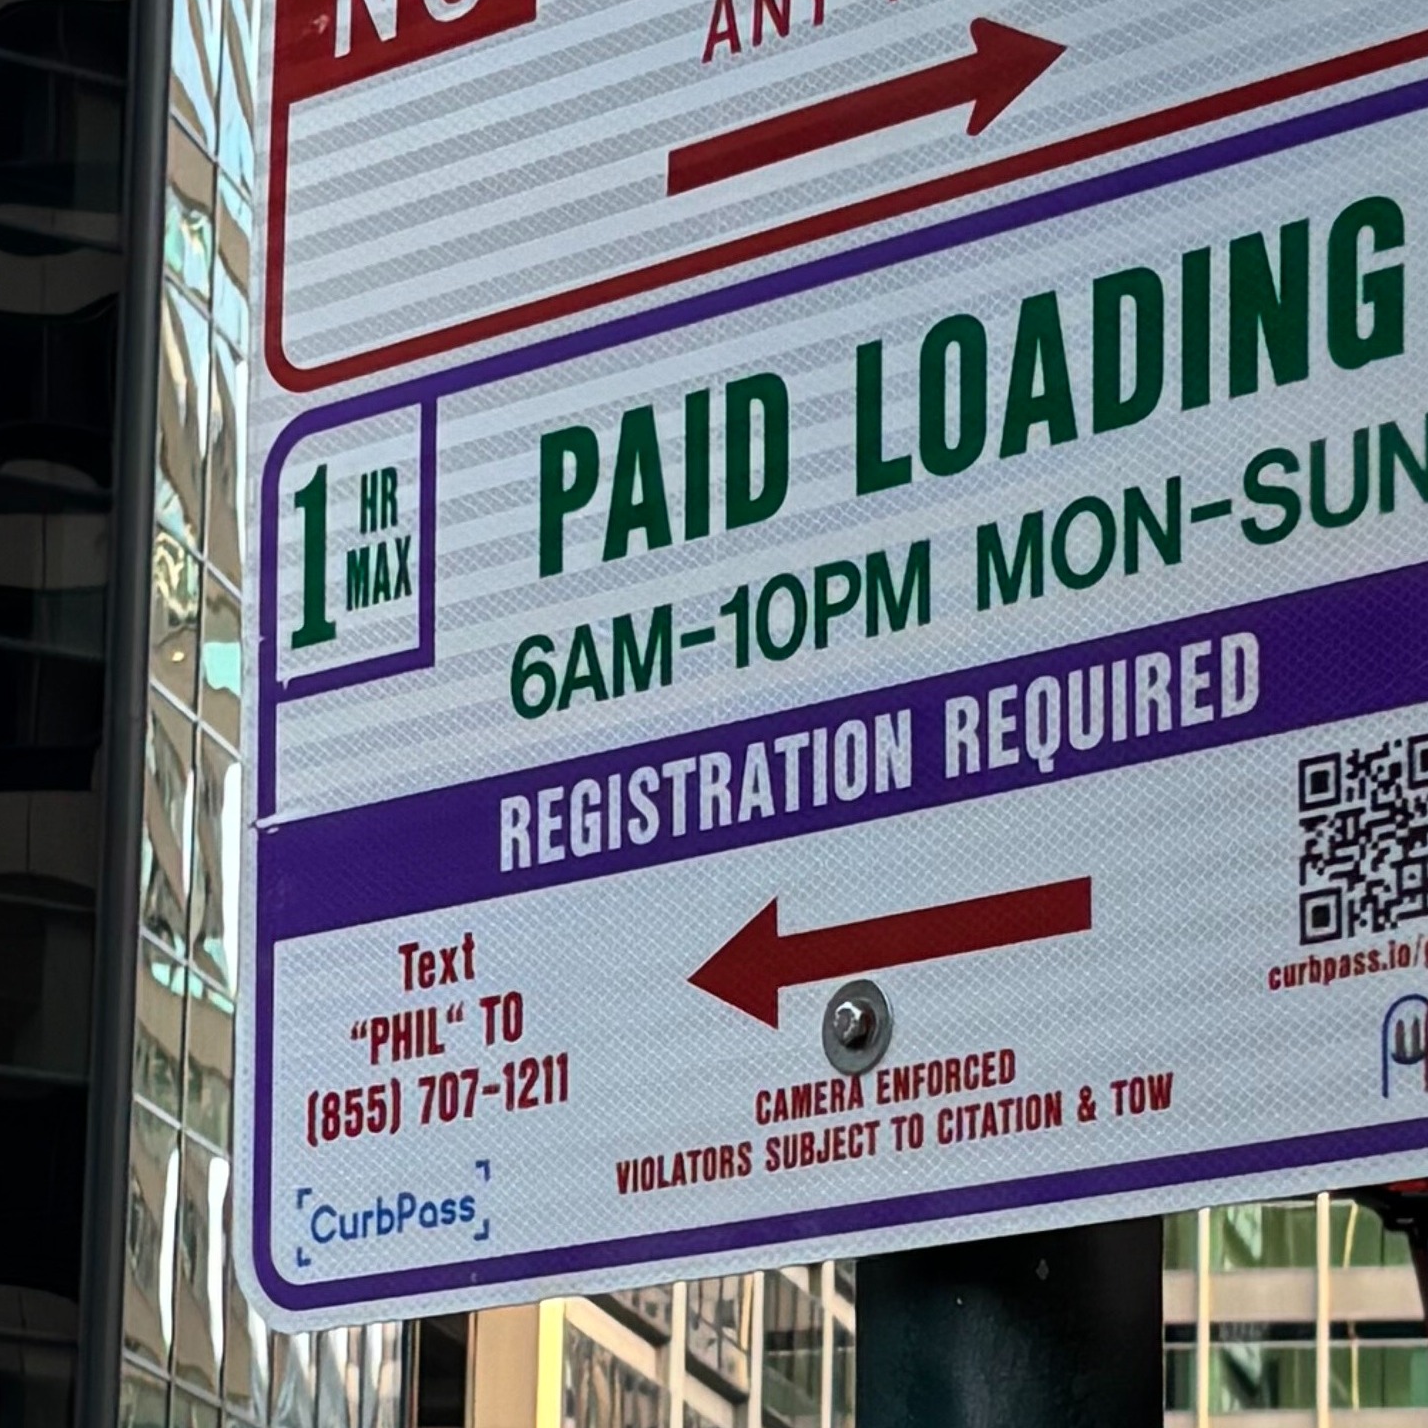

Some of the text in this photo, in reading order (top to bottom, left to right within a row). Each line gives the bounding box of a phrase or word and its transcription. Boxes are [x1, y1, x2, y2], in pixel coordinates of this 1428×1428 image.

[539, 196, 1405, 578] PAID LOADING
[359, 466, 399, 535] HR
[291, 463, 336, 650] 1
[346, 535, 413, 612] MAX
[511, 539, 931, 719] 6AM-10PM
[501, 633, 1258, 871] REGISTRATION REQUIRED
[400, 932, 475, 991] Text
[480, 991, 523, 1044] TO
[306, 1052, 570, 1146] (855) 707-1211
[755, 1049, 1015, 1125] CAMERA ENFORCED
[616, 1072, 1174, 1194] VIOLATORS SUBJECT TO CITATION & TOW
[310, 1192, 476, 1244] CurbPass
